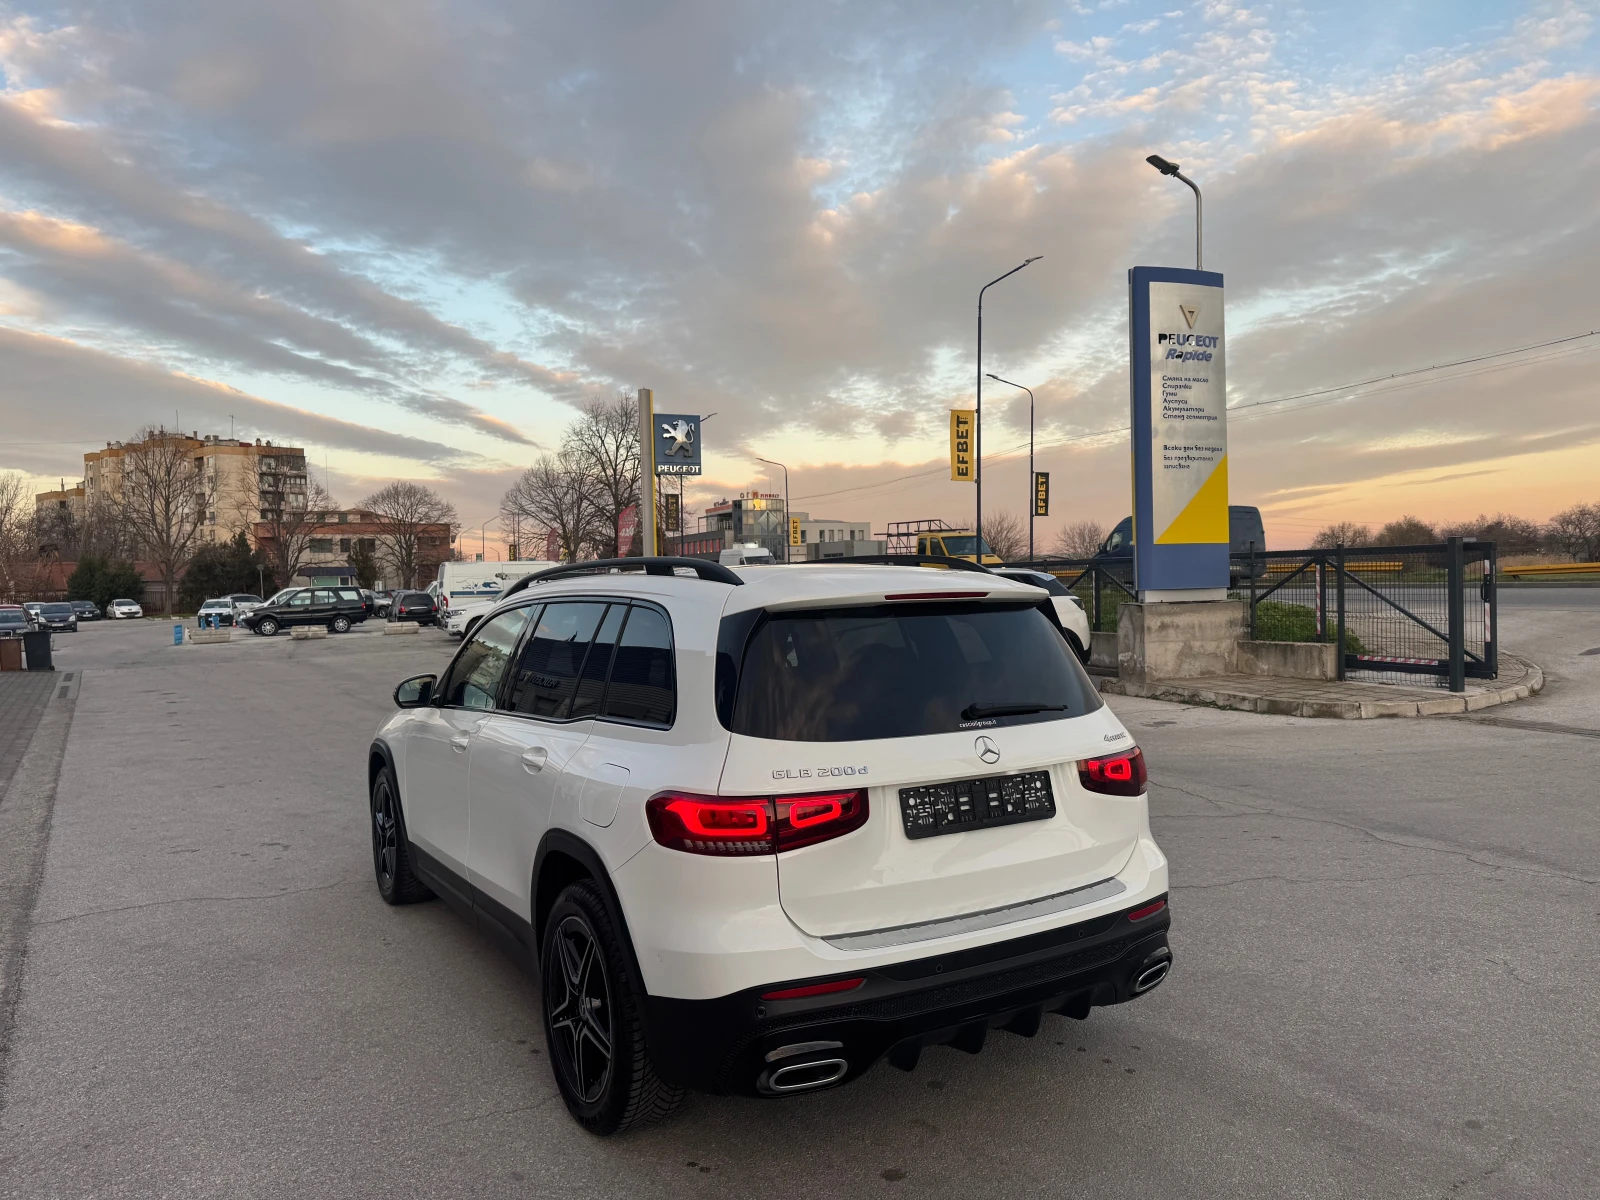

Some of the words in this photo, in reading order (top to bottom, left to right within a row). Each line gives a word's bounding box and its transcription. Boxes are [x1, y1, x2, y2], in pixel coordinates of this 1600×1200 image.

[1158, 333, 1219, 348] PEUGEOT
[1165, 348, 1213, 363] Rapide
[956, 415, 968, 476] EFBET
[657, 464, 701, 473] PEUGEOT
[1038, 475, 1047, 513] EFBET
[772, 768, 813, 780] GLB
